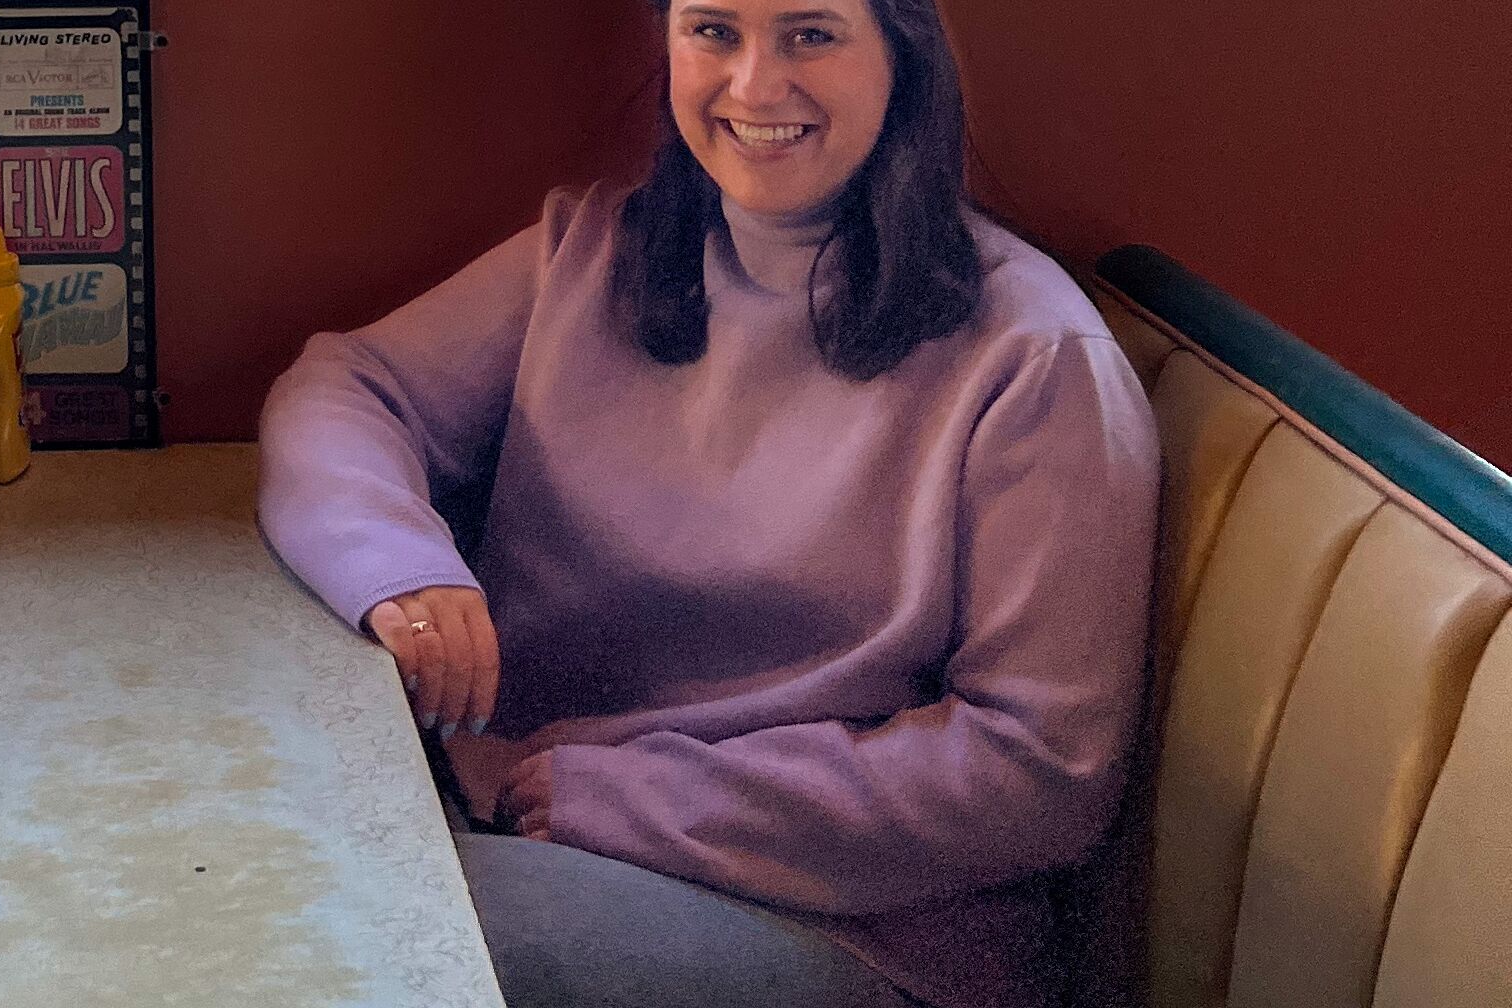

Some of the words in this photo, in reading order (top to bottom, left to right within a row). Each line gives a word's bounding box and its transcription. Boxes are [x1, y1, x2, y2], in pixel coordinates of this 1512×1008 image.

[0, 34, 48, 46] LIVING
[56, 32, 111, 45] STEREO
[30, 95, 84, 107] PRESENTS
[28, 118, 62, 130] GREAT
[66, 117, 100, 129] SONGS
[1, 158, 116, 239] ELVIS
[23, 270, 103, 320] BLUE
